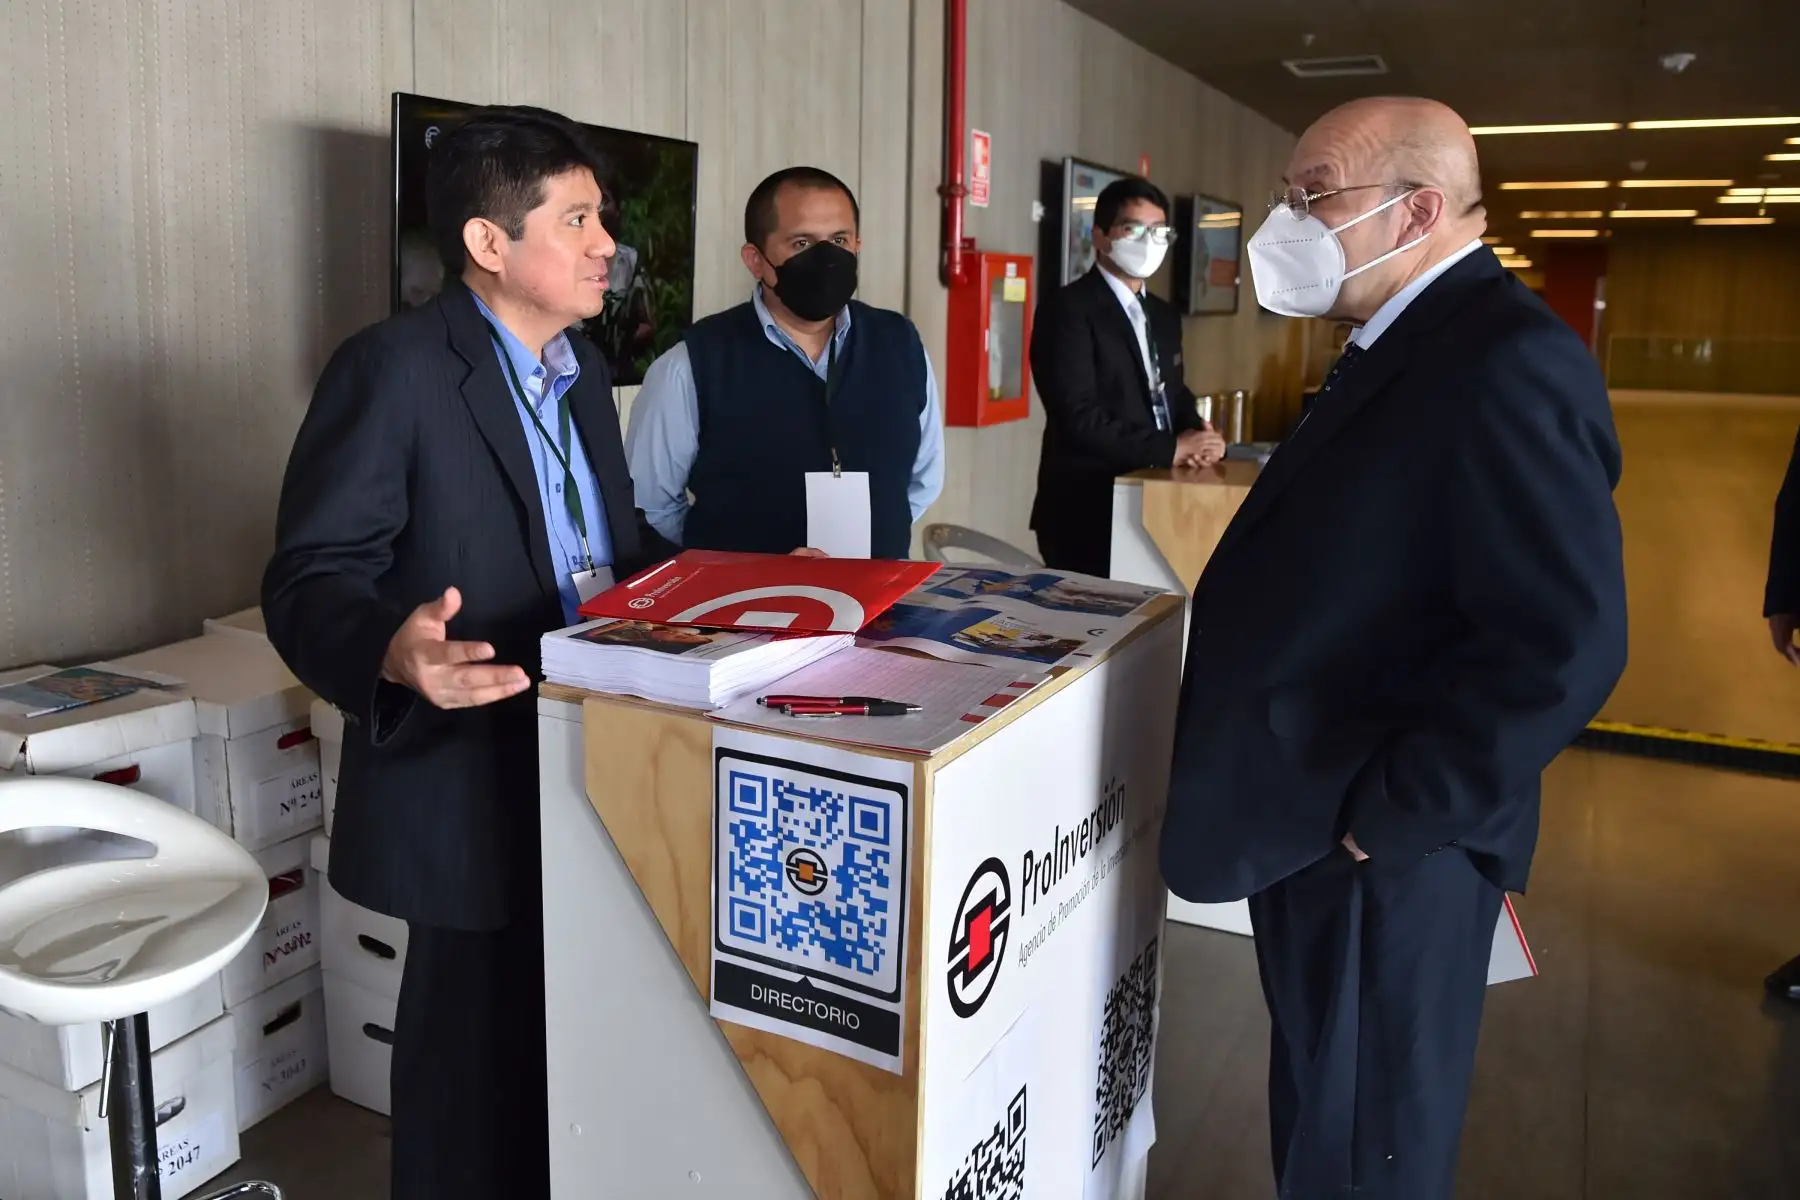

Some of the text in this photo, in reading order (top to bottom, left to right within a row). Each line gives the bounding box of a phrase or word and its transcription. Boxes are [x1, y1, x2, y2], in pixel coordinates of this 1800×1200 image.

[1021, 776, 1125, 917] ProInversión
[1018, 923, 1046, 968] Agencia
[1047, 911, 1057, 936] de
[1058, 881, 1091, 927] Promoción
[1091, 868, 1099, 891] de
[1100, 858, 1106, 881] la
[751, 983, 860, 1030] DIRECTORIO
[168, 1144, 200, 1176] 2047
